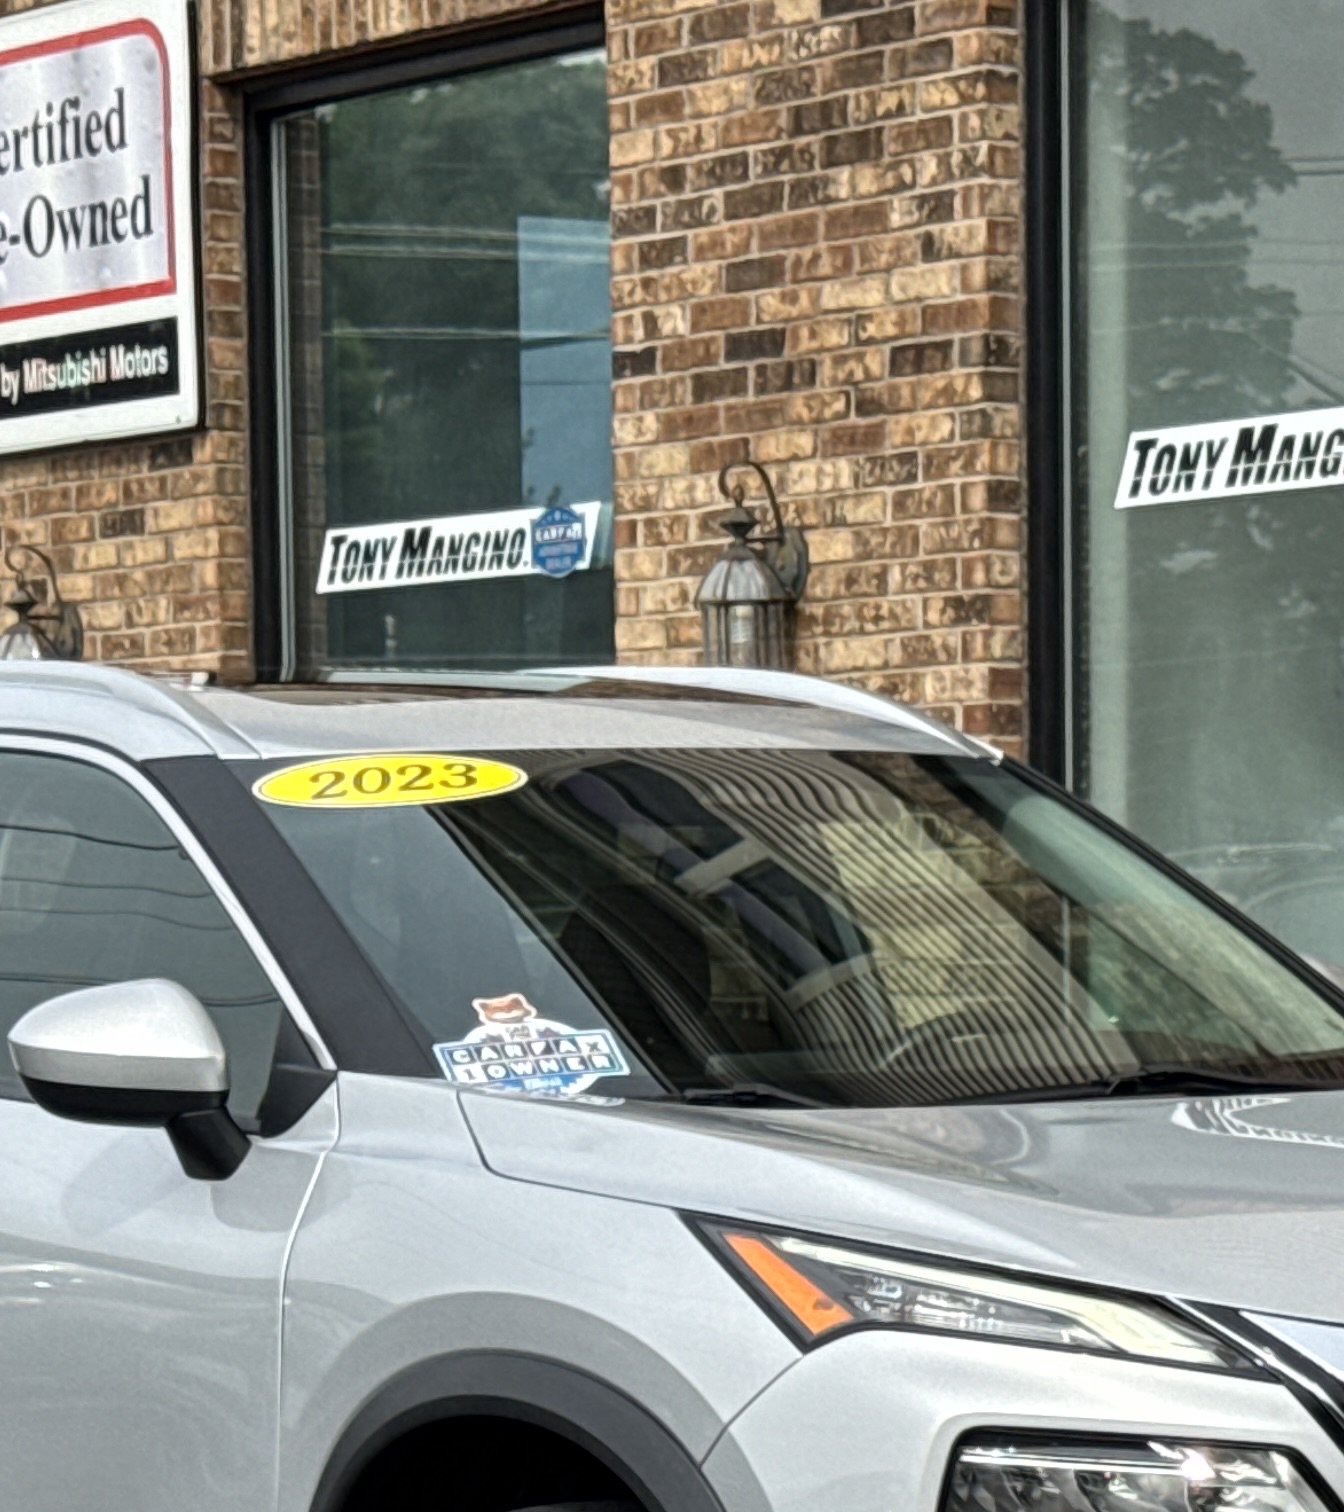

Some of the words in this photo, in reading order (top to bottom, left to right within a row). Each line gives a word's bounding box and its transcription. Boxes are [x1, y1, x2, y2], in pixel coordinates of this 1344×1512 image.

[0, 362, 20, 406] by
[22, 346, 107, 395] Mitsubishi
[109, 343, 169, 382] Motors
[1127, 437, 1229, 499] TONY
[326, 533, 398, 585] TONY
[309, 763, 478, 800] 2023
[452, 1037, 602, 1064] CARFAX
